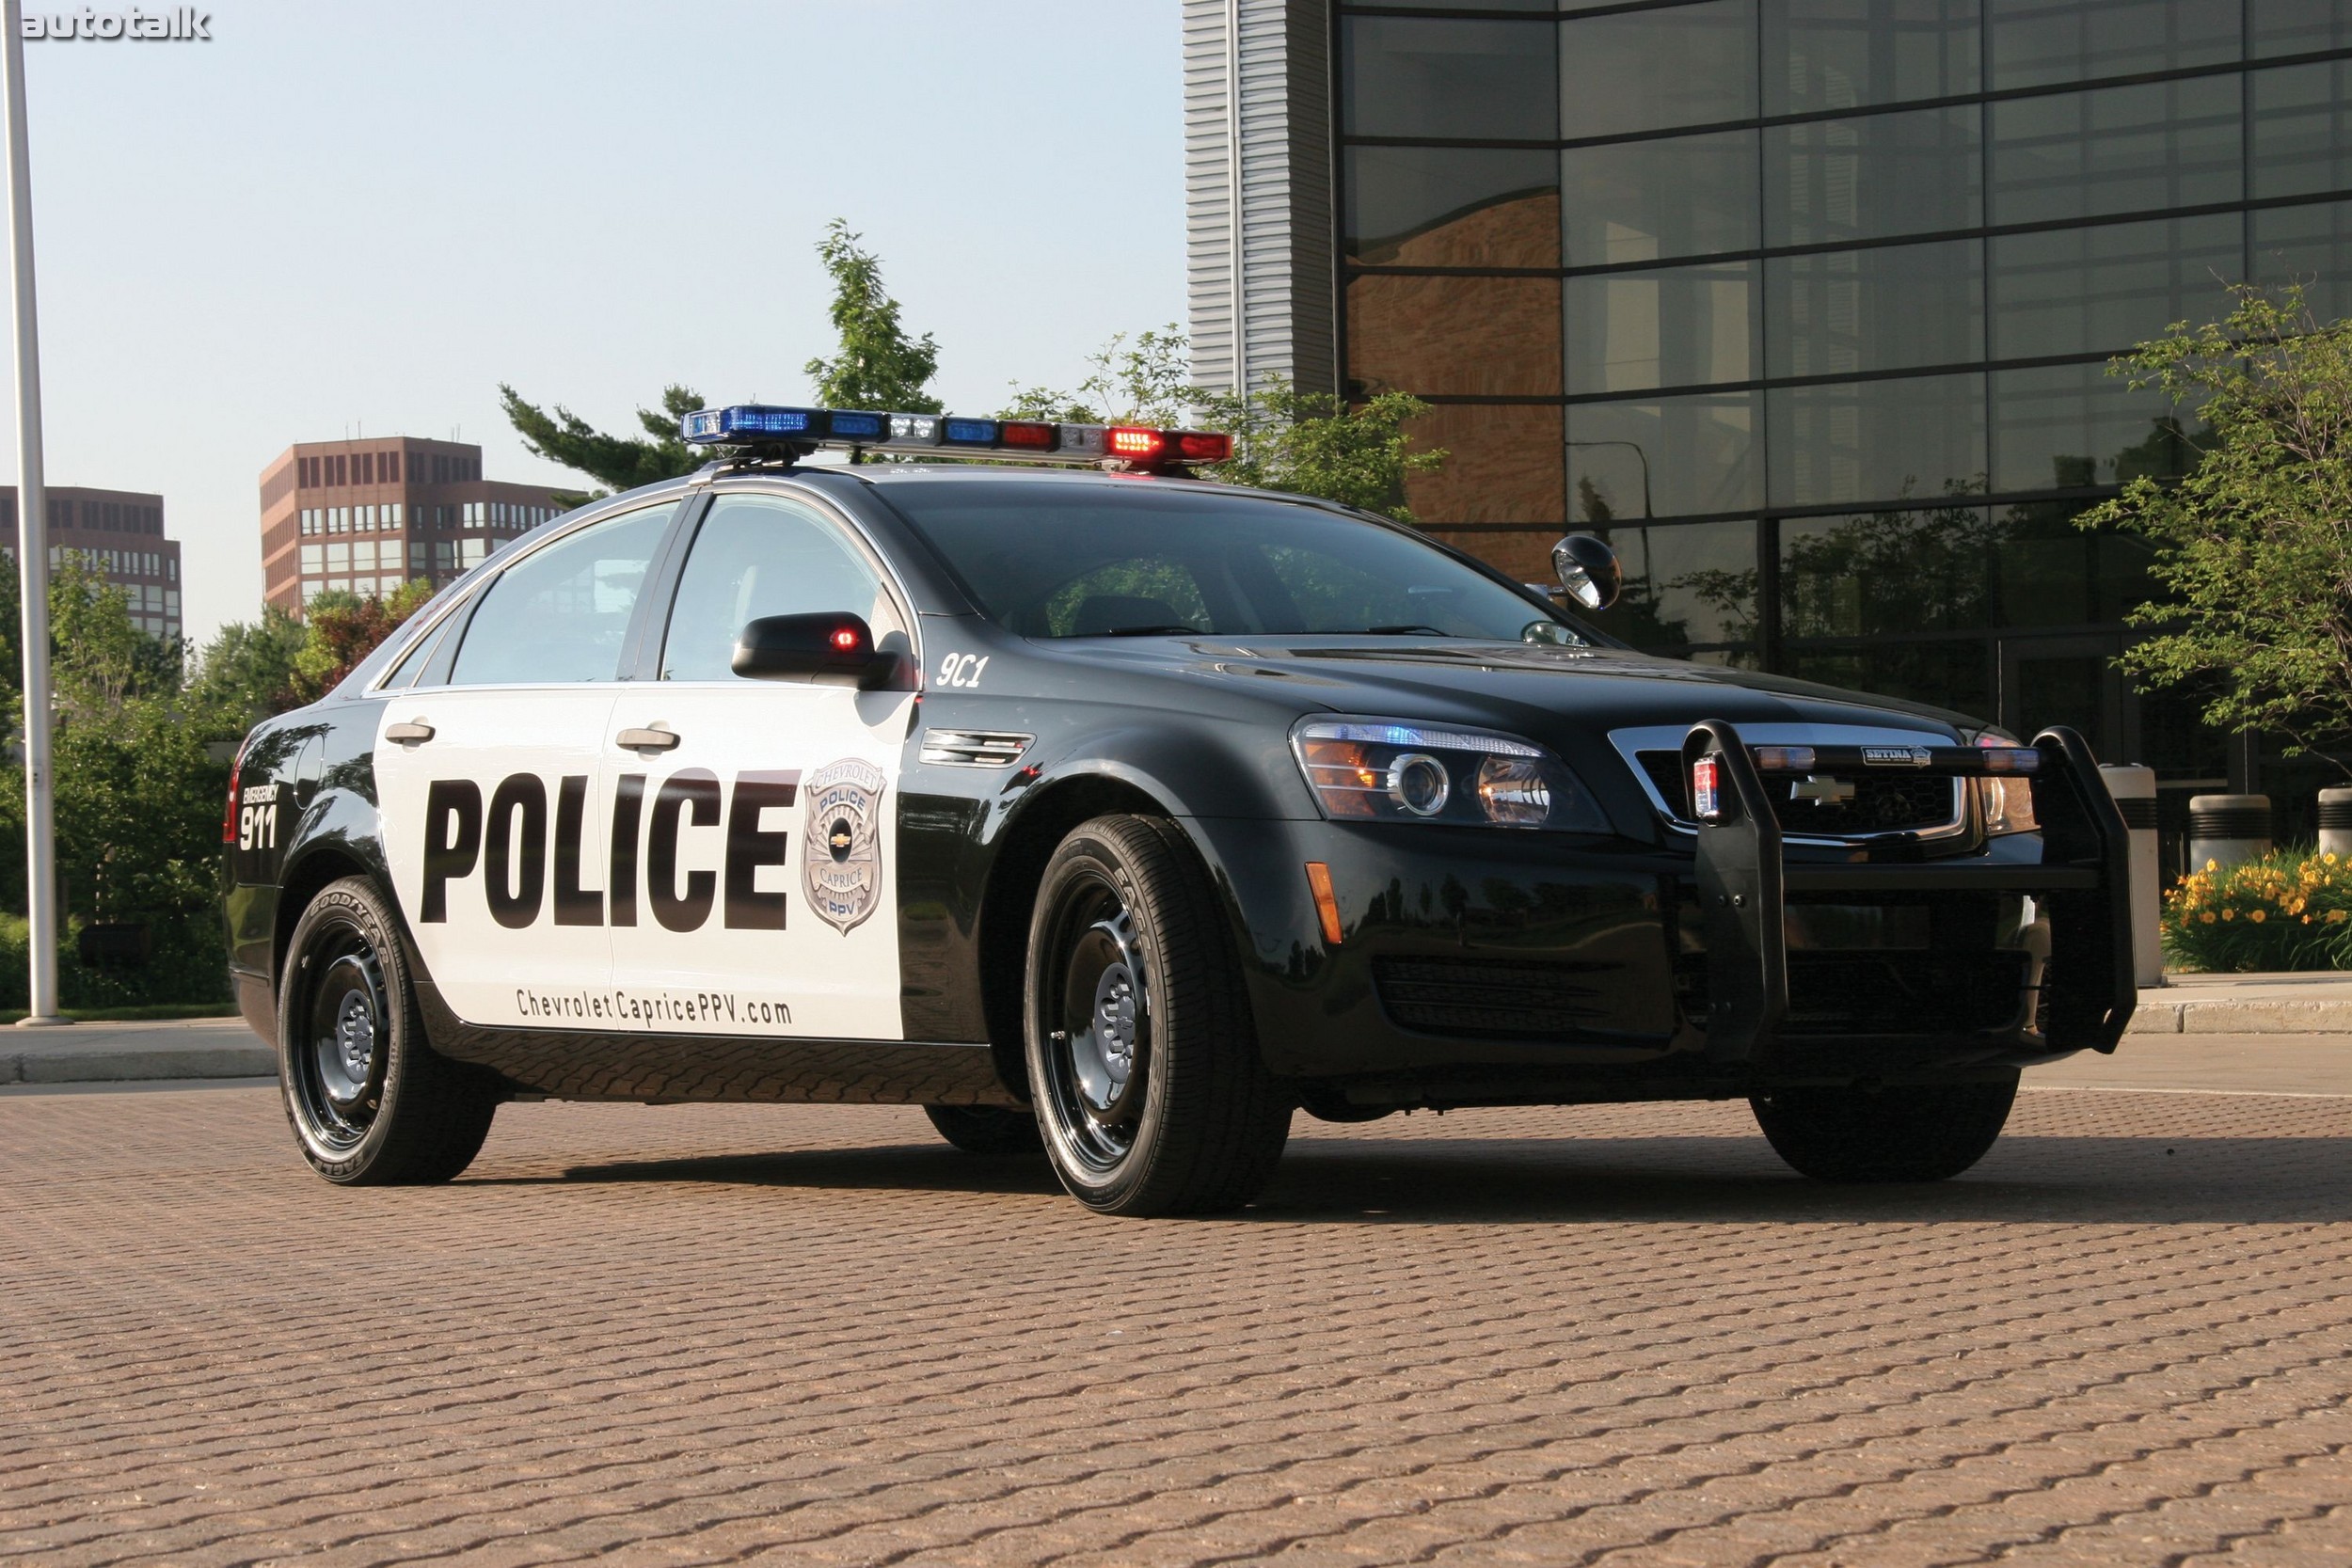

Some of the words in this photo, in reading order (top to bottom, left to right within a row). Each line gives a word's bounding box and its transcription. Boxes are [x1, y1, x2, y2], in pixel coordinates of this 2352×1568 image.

[935, 652, 990, 688] 9C1
[1866, 749, 1912, 758] SETINA
[243, 784, 279, 804] EMERGENCY
[815, 764, 877, 790] CHEVROLET
[819, 789, 866, 813] POLICE
[240, 804, 277, 850] 911
[420, 767, 803, 933] POLICE
[819, 868, 863, 888] CAPRICE
[310, 893, 389, 964] GOODYEAR
[1114, 867, 1158, 993] EAGLE
[516, 989, 792, 1028] ChevroletCapricePPV.com
